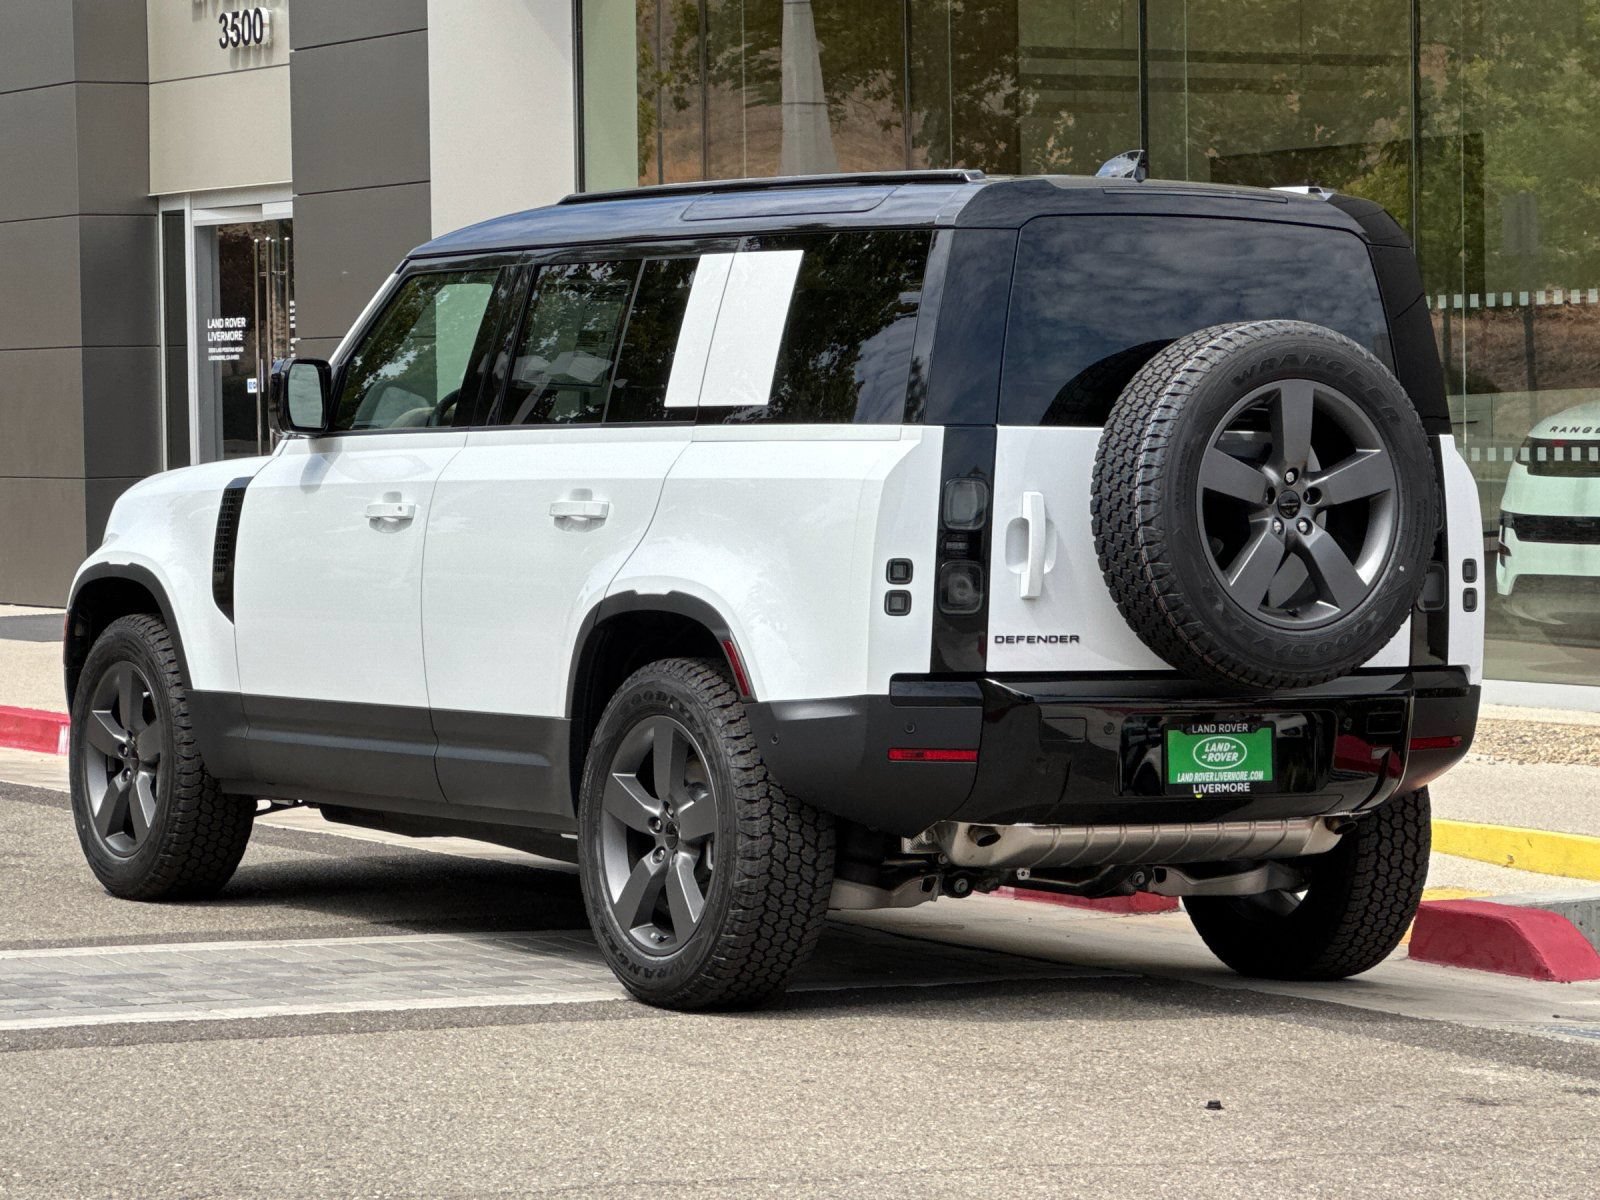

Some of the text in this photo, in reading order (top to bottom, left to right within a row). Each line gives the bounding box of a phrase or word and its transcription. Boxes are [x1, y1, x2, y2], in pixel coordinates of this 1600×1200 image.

[218, 7, 264, 49] 3500
[207, 317, 246, 329] LAND ROVER
[207, 330, 243, 341] LIVERMORE
[994, 635, 1080, 644] DEFENDER
[1191, 723, 1249, 733] LAND ROVER
[1204, 742, 1231, 752] LAND
[1207, 752, 1239, 762] ROVER
[1193, 782, 1250, 793] LIVERMORE
